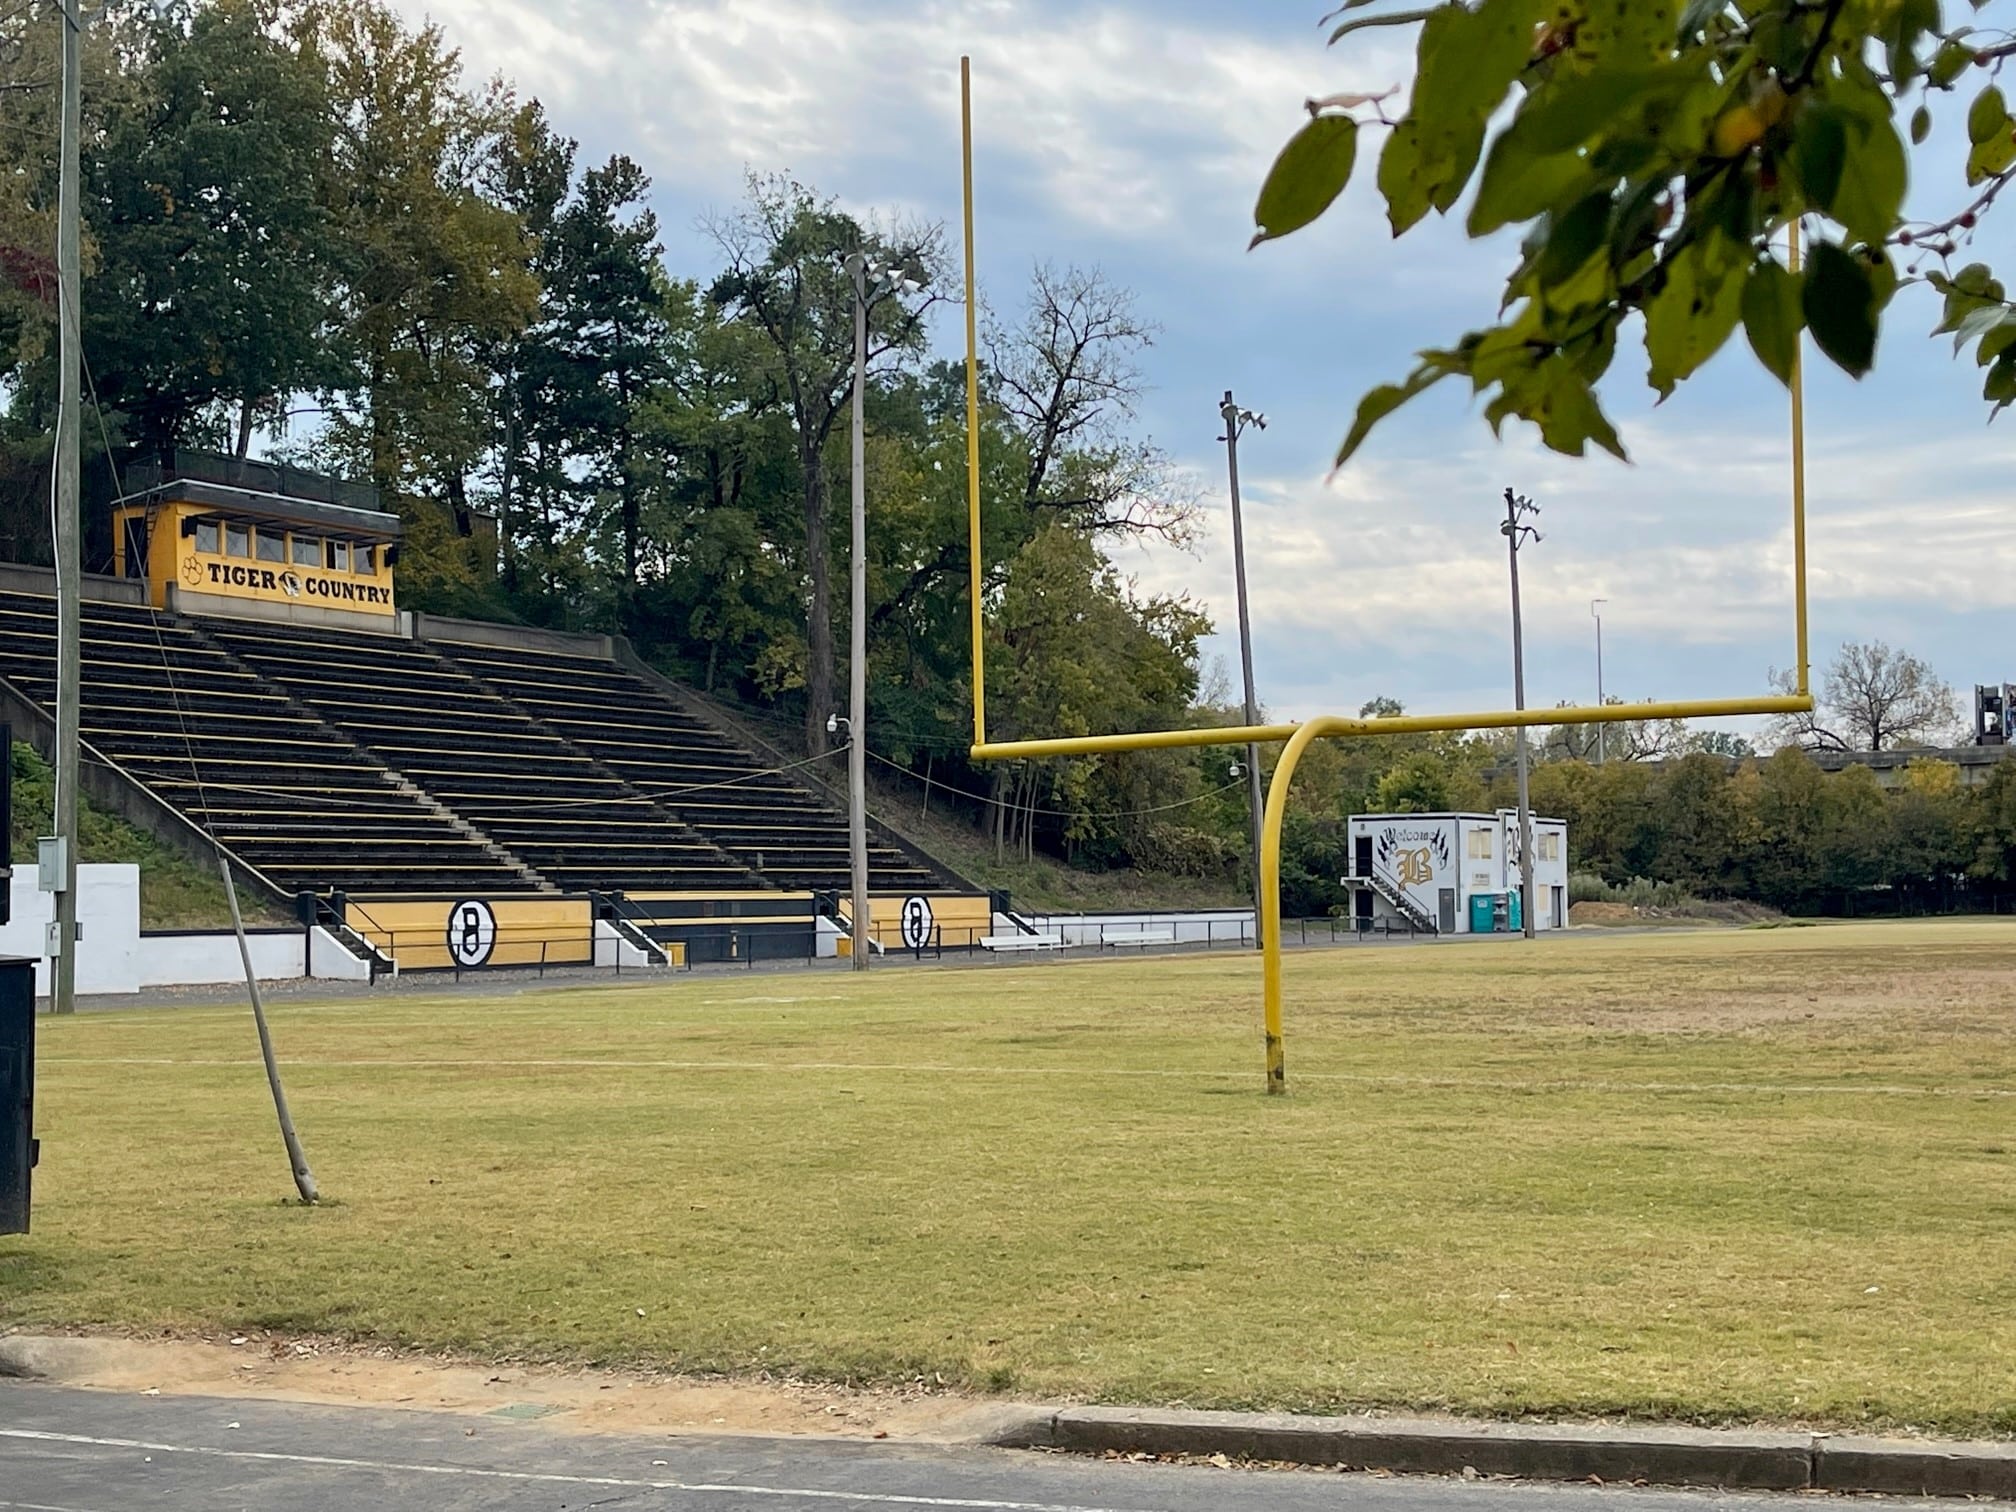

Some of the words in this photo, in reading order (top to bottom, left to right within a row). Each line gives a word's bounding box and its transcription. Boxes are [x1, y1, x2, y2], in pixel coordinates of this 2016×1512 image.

[207, 562, 277, 590] TIGER
[305, 577, 390, 604] COUNTRY
[1383, 827, 1437, 842] Welcome
[1394, 847, 1433, 891] B
